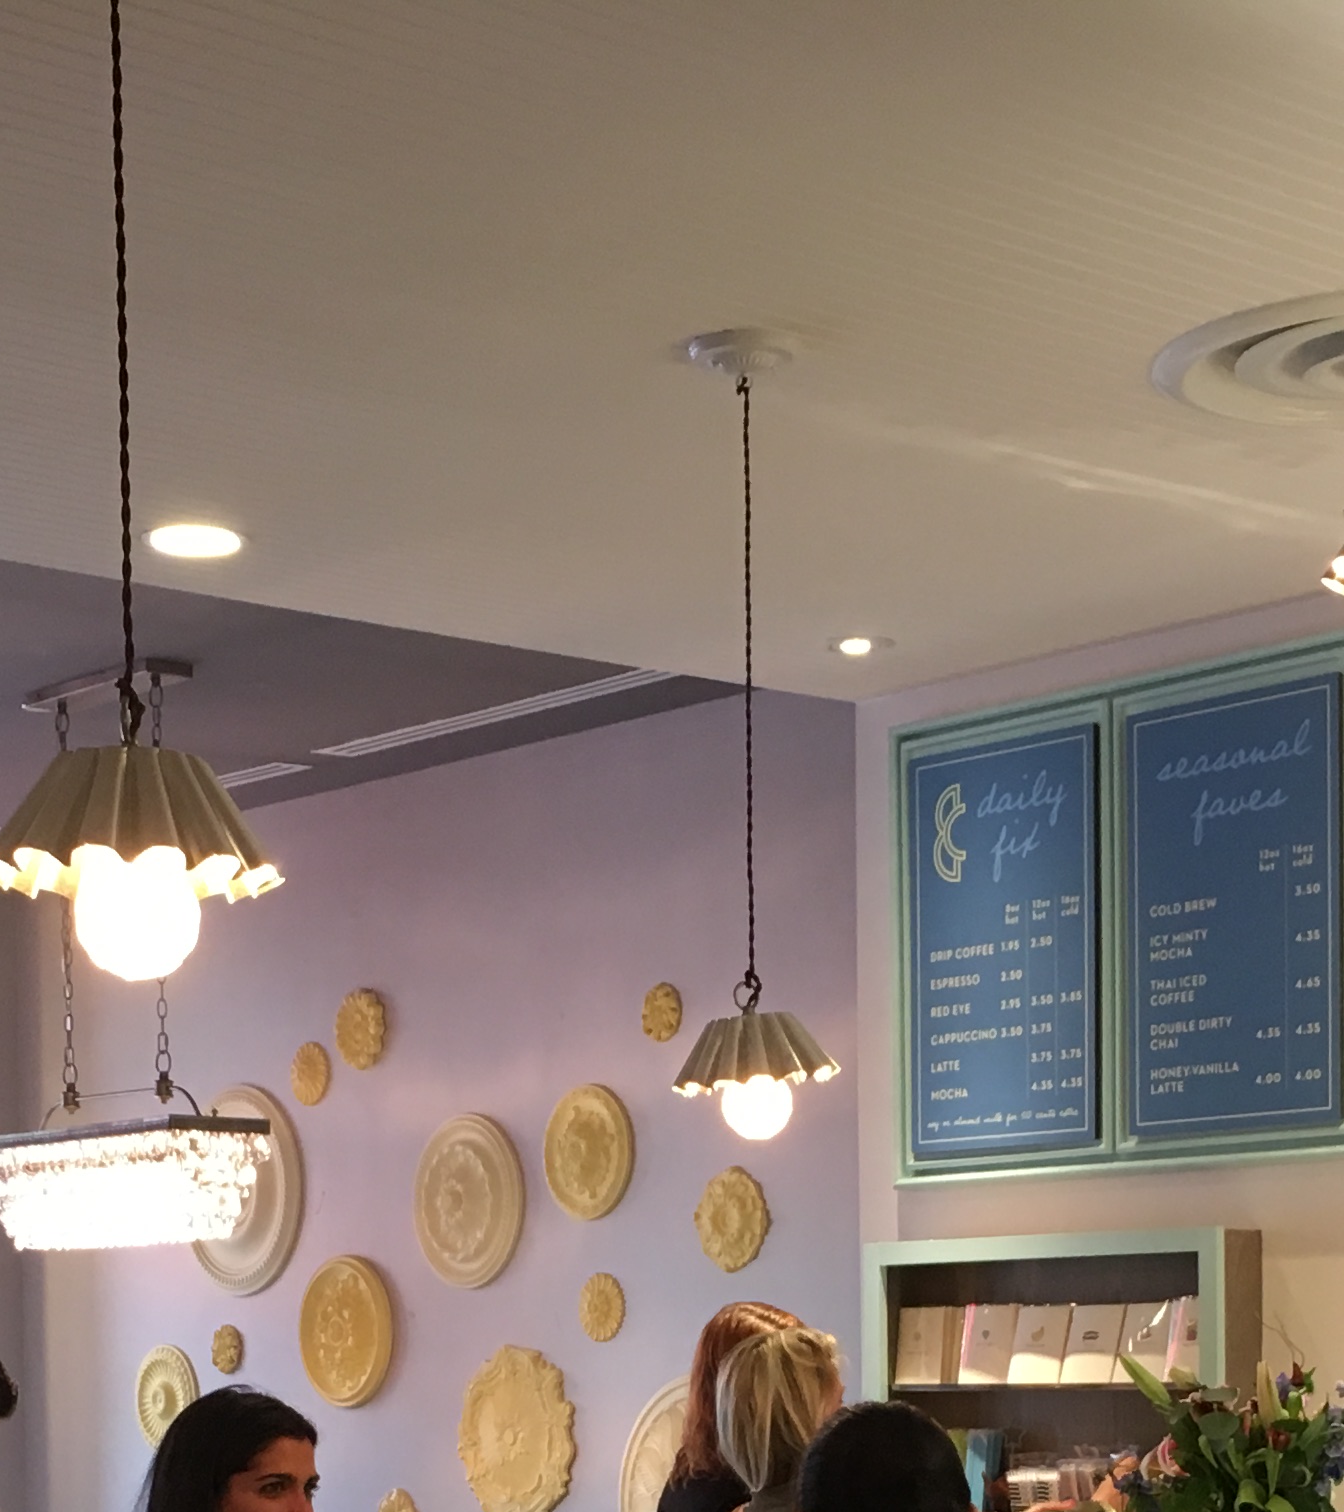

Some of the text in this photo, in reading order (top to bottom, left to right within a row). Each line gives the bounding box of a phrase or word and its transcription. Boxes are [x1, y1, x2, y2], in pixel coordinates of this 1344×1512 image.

[1156, 718, 1313, 781] seasonal
[977, 769, 1068, 827] daily
[1191, 788, 1289, 846] faves
[990, 818, 1041, 883] fix
[1292, 854, 1313, 867] cold
[1149, 883, 1321, 918] COLD BREW 3.50
[1150, 934, 1169, 947] ICY
[1172, 929, 1209, 944] MINTY
[930, 950, 952, 963] DRIP
[955, 943, 995, 960] COFFEE
[1030, 935, 1053, 949] 2.50
[1150, 947, 1193, 962] MOCHA
[930, 974, 981, 991] ESPRESSO
[1150, 979, 1176, 991] THAI
[1179, 974, 1207, 988] ICED
[1150, 990, 1195, 1007] COFFEE
[930, 1006, 950, 1018] RED
[952, 1003, 971, 1016] EYE
[930, 1028, 997, 1046] CAPPUCCINO
[1031, 1022, 1052, 1035] 3.75
[1150, 1020, 1195, 1036] DOUBLE
[1198, 1016, 1233, 1030] DIRTY
[1150, 1038, 1179, 1050] CHAI
[930, 1060, 960, 1073] LATTE
[1031, 1051, 1053, 1063] 3.75
[1255, 1072, 1281, 1085] 4.00
[1294, 1068, 1322, 1081] 4.00
[930, 1088, 968, 1101] MOCHA
[1150, 1081, 1184, 1095] LATTE
